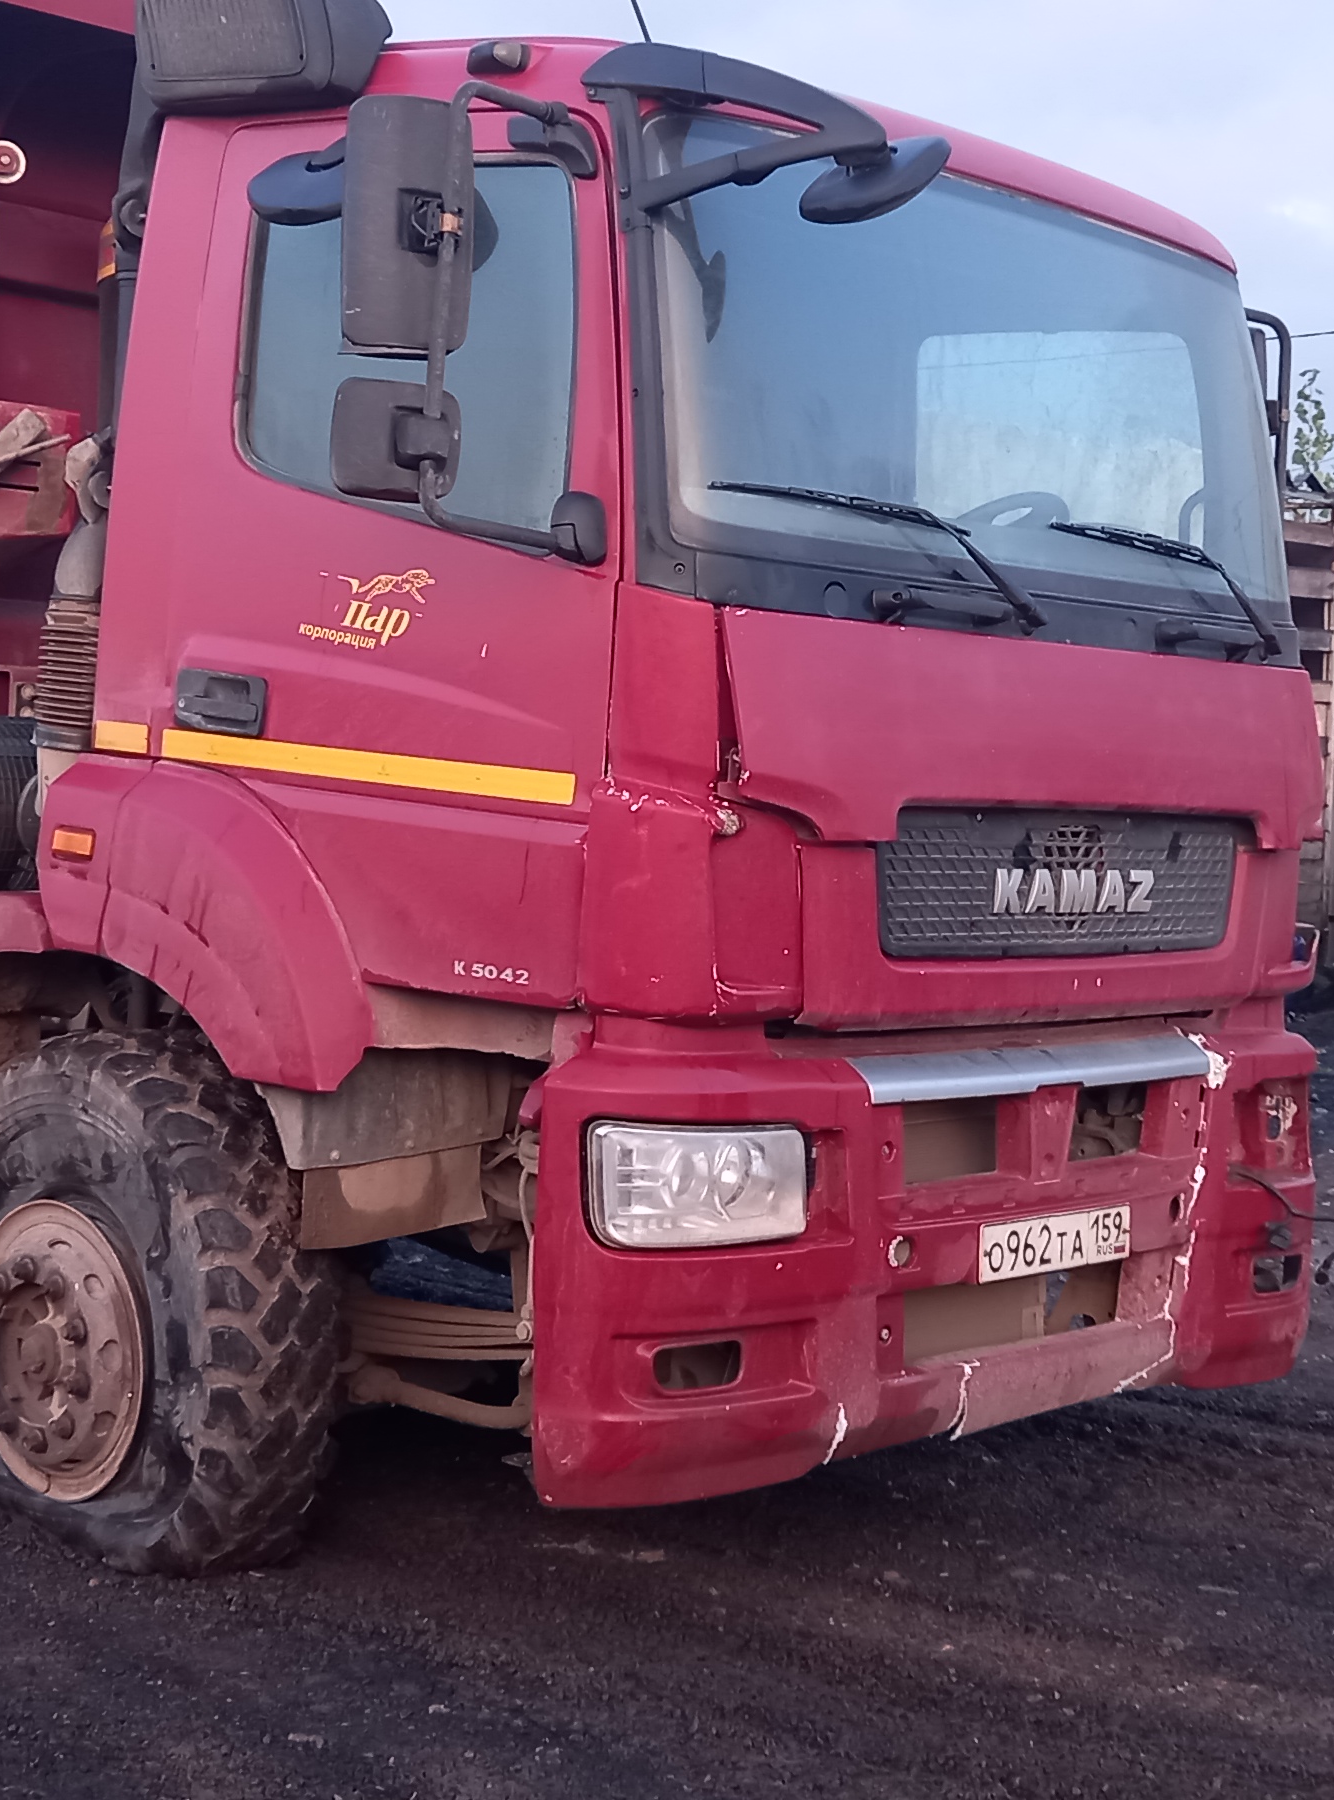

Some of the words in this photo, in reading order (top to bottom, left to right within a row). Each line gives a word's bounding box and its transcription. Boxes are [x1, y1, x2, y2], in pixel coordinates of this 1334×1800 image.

[298, 623, 378, 650] корпорация
[340, 600, 410, 646] Пар
[992, 868, 1155, 914] KAMAZ
[454, 961, 466, 975] K
[471, 963, 529, 984] 5042
[1091, 1211, 1123, 1244] 159
[1096, 1243, 1113, 1257] RUS
